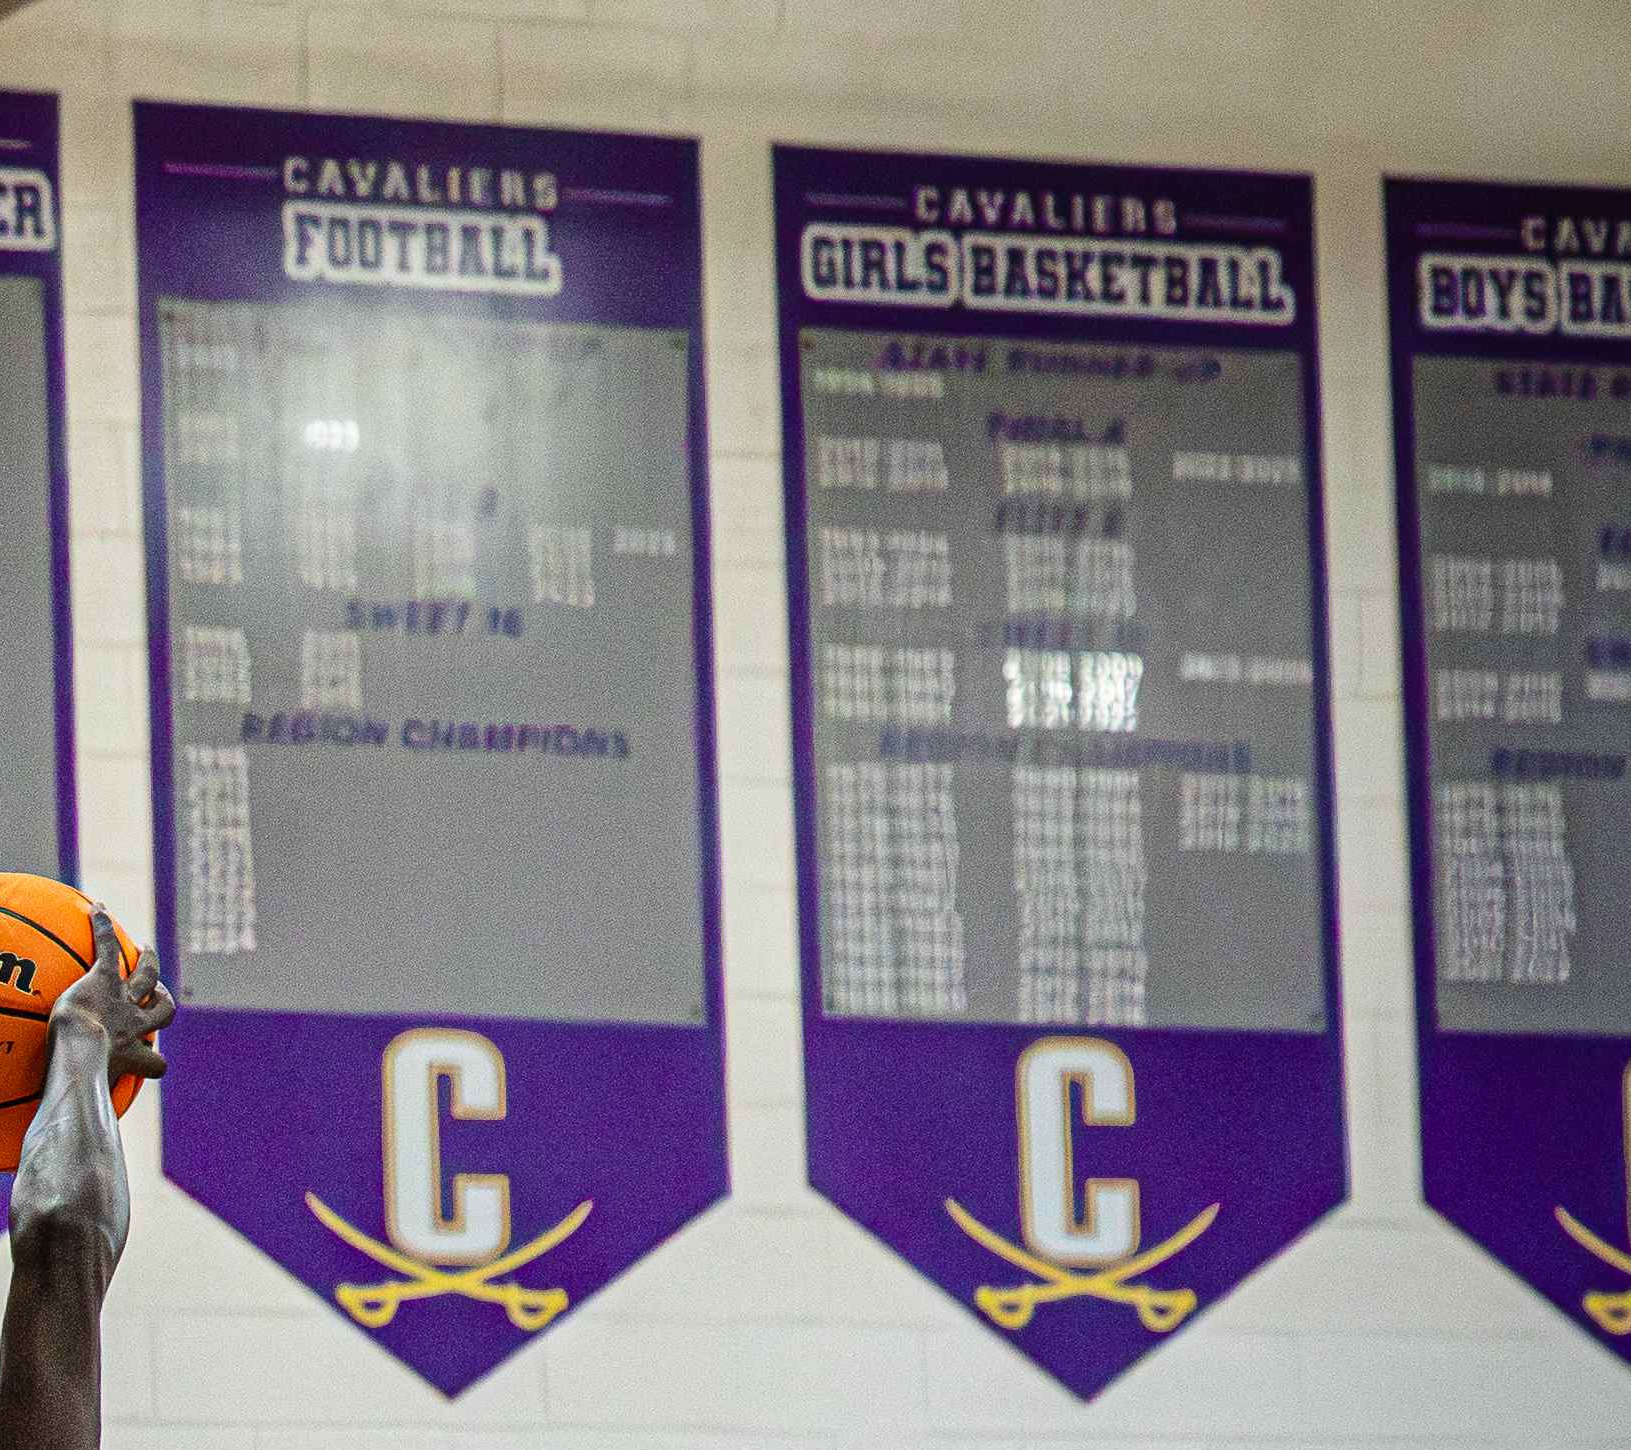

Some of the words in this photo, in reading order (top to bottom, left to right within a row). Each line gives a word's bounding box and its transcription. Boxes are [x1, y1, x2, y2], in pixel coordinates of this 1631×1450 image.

[283, 156, 559, 211] CAVALIERS
[914, 185, 1179, 235] CAVALIERS
[289, 209, 555, 286] FOOTBALL
[809, 231, 953, 297] GIRLS
[968, 242, 1290, 316] BASKETBALL
[1429, 263, 1548, 325] BOYS
